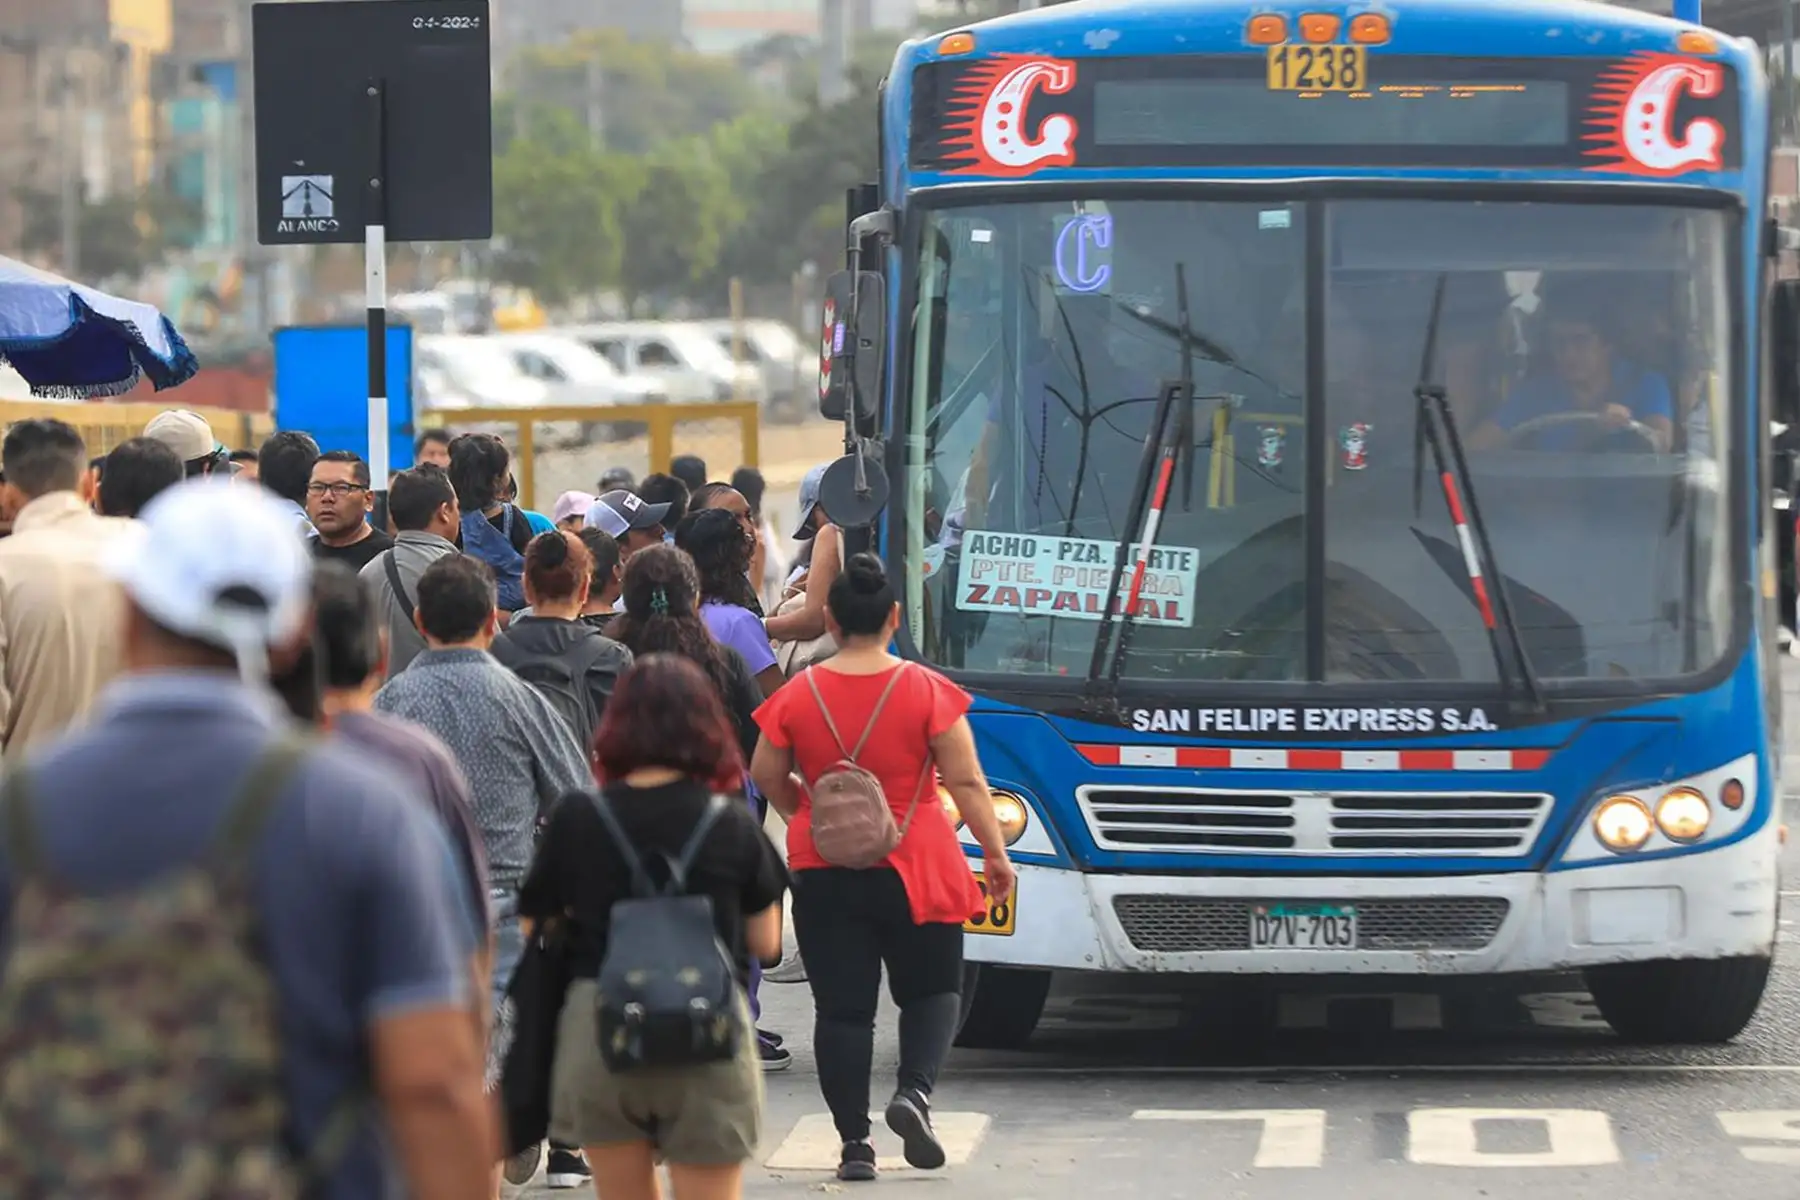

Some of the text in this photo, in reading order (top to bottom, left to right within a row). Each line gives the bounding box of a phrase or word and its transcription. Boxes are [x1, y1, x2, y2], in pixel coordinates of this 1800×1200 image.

[1273, 46, 1358, 89] 1238
[277, 218, 340, 233] ALANCO
[1054, 214, 1113, 293] C
[969, 534, 1037, 559] ACHO
[1057, 540, 1107, 565] PZA.
[970, 558, 1043, 585] PTE.
[1132, 707, 1499, 732] SAN FELIPE EXPRESS S.A.
[1255, 915, 1352, 946] D7V-703
